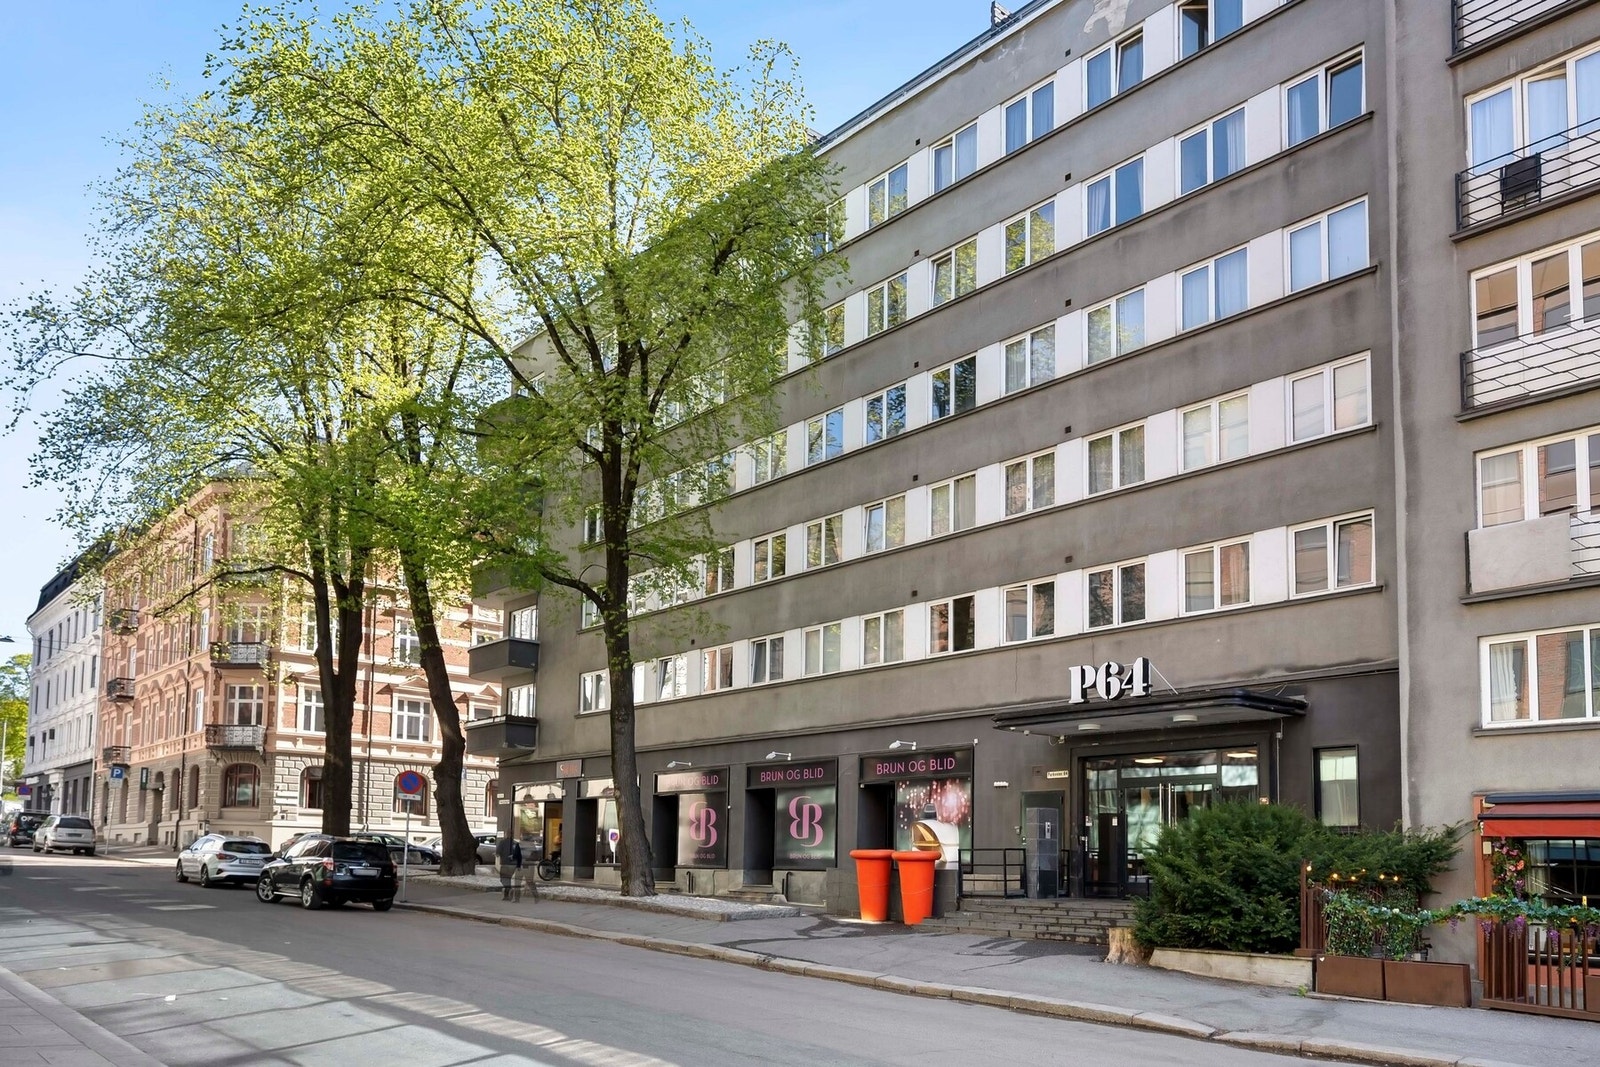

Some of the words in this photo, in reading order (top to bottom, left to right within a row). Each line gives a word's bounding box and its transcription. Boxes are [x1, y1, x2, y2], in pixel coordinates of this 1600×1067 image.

[1068, 656, 1150, 704] P64
[876, 761, 905, 775] BRUN
[908, 759, 926, 772] OG
[929, 757, 955, 771] BLID
[701, 774, 719, 785] BLID
[760, 770, 784, 782] BRUN
[786, 768, 801, 780] OG
[803, 767, 824, 779] BLID
